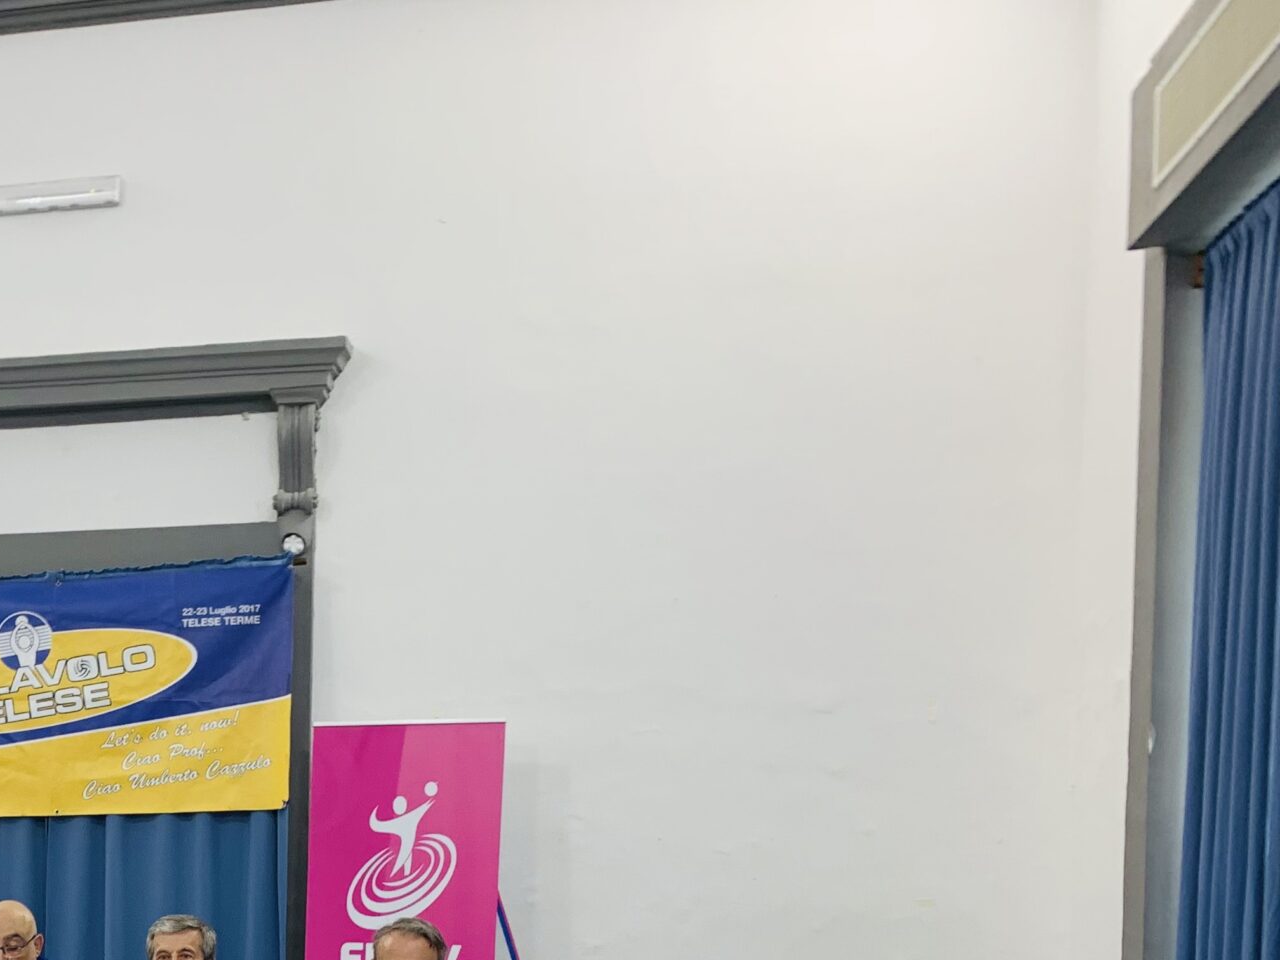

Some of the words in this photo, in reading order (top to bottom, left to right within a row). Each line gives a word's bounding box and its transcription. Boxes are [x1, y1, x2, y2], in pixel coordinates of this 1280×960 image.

[182, 606, 208, 616] 22-23
[209, 605, 237, 616] Luglio
[238, 604, 261, 613] 2017
[182, 617, 221, 628] TELESE
[223, 615, 261, 625] TERME
[149, 726, 169, 740] do
[200, 710, 240, 731] now!
[122, 751, 161, 770] Ciao
[82, 780, 122, 800] Ciao
[129, 769, 198, 790] Umberto
